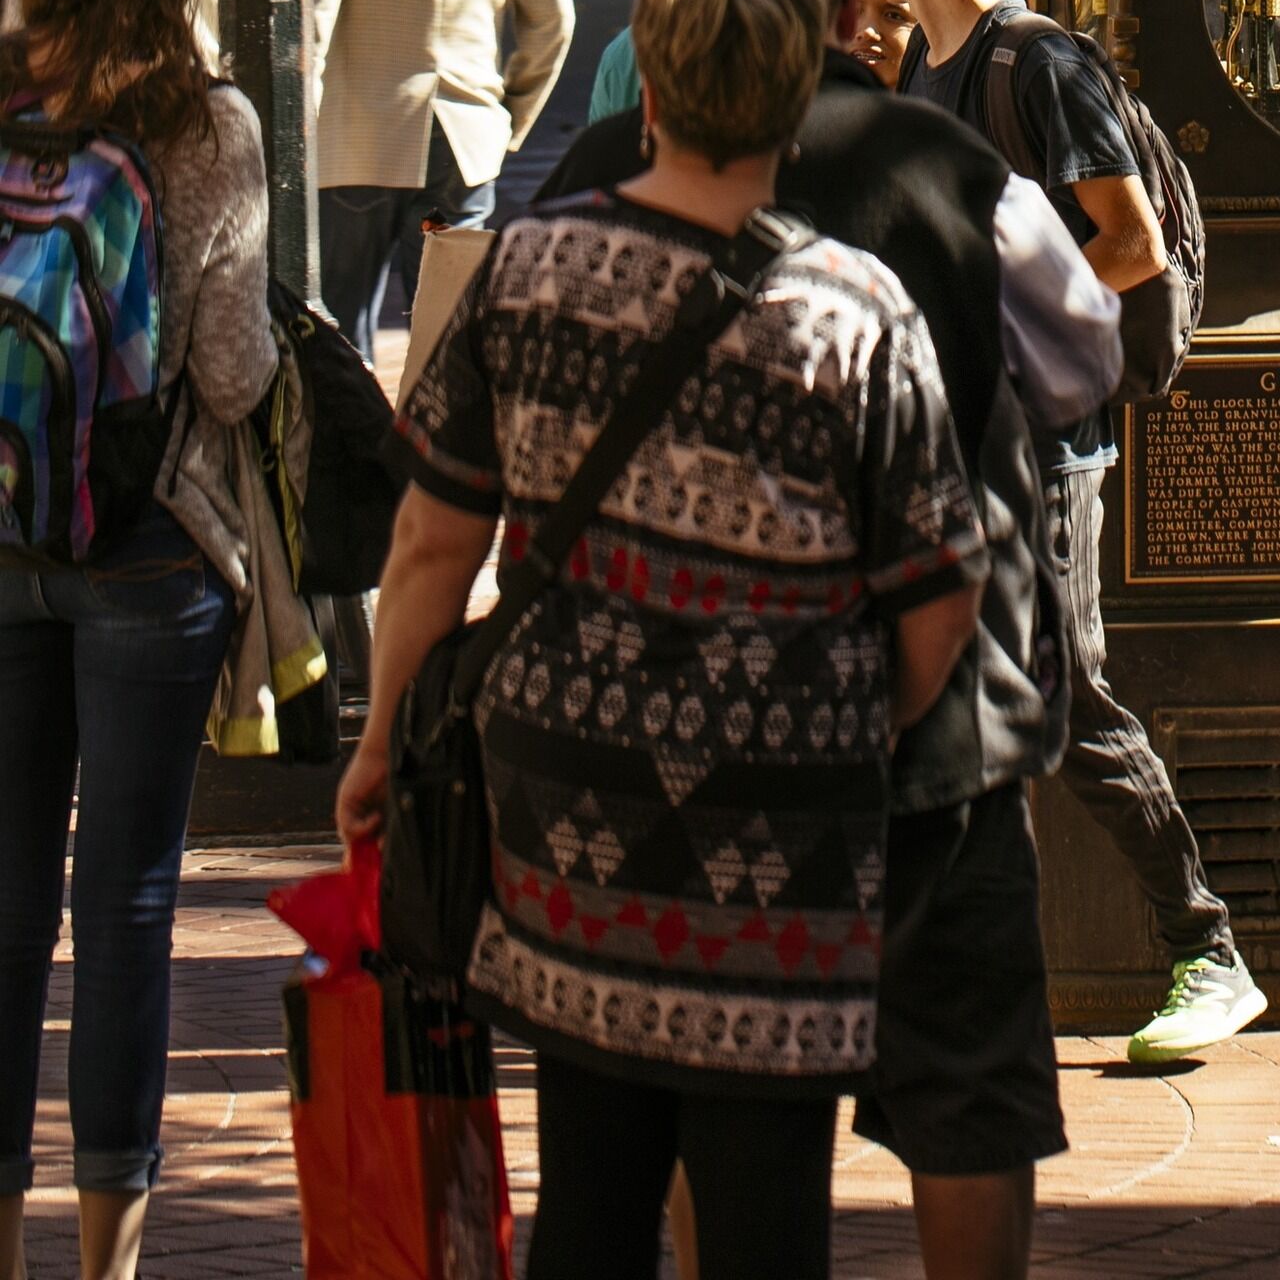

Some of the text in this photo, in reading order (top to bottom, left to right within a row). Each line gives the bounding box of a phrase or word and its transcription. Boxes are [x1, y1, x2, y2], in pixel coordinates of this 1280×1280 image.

[1170, 390, 1208, 409] THIS
[1213, 398, 1253, 409] CLOCK
[1257, 398, 1266, 408] IS
[1147, 412, 1162, 422] OF
[1166, 412, 1189, 422] THE
[1194, 411, 1219, 421] OLD
[1147, 423, 1160, 433] IN
[1198, 422, 1220, 432] THE
[1225, 421, 1265, 431] SHORE
[1147, 434, 1187, 445] YARDS
[1192, 433, 1233, 444] NORTH
[1238, 433, 1252, 442] OF
[1147, 445, 1204, 455] GASTOWN
[1212, 444, 1237, 454] WAS
[1242, 443, 1263, 453] THE
[1147, 456, 1160, 465] BY
[1166, 455, 1187, 465] THE
[1233, 454, 1244, 463] IT
[1246, 453, 1272, 463] HAD
[1223, 465, 1236, 475] IN
[1240, 465, 1262, 475] THE
[1148, 478, 1164, 488] ITS
[1169, 477, 1220, 487] FORMER
[1148, 489, 1173, 499] WAS
[1179, 488, 1201, 498] DUE
[1208, 488, 1223, 497] TO
[1147, 500, 1194, 511] PEOPLE
[1199, 499, 1214, 509] OF
[1221, 498, 1280, 509] GASTOWN
[1147, 509, 1204, 521] COUNCIL
[1213, 509, 1239, 519] AND
[1215, 531, 1249, 541] WERE
[1147, 545, 1162, 554] OF
[1166, 544, 1187, 554] THE
[1148, 556, 1169, 566] THE
[1175, 554, 1246, 565] COMMITTEE
